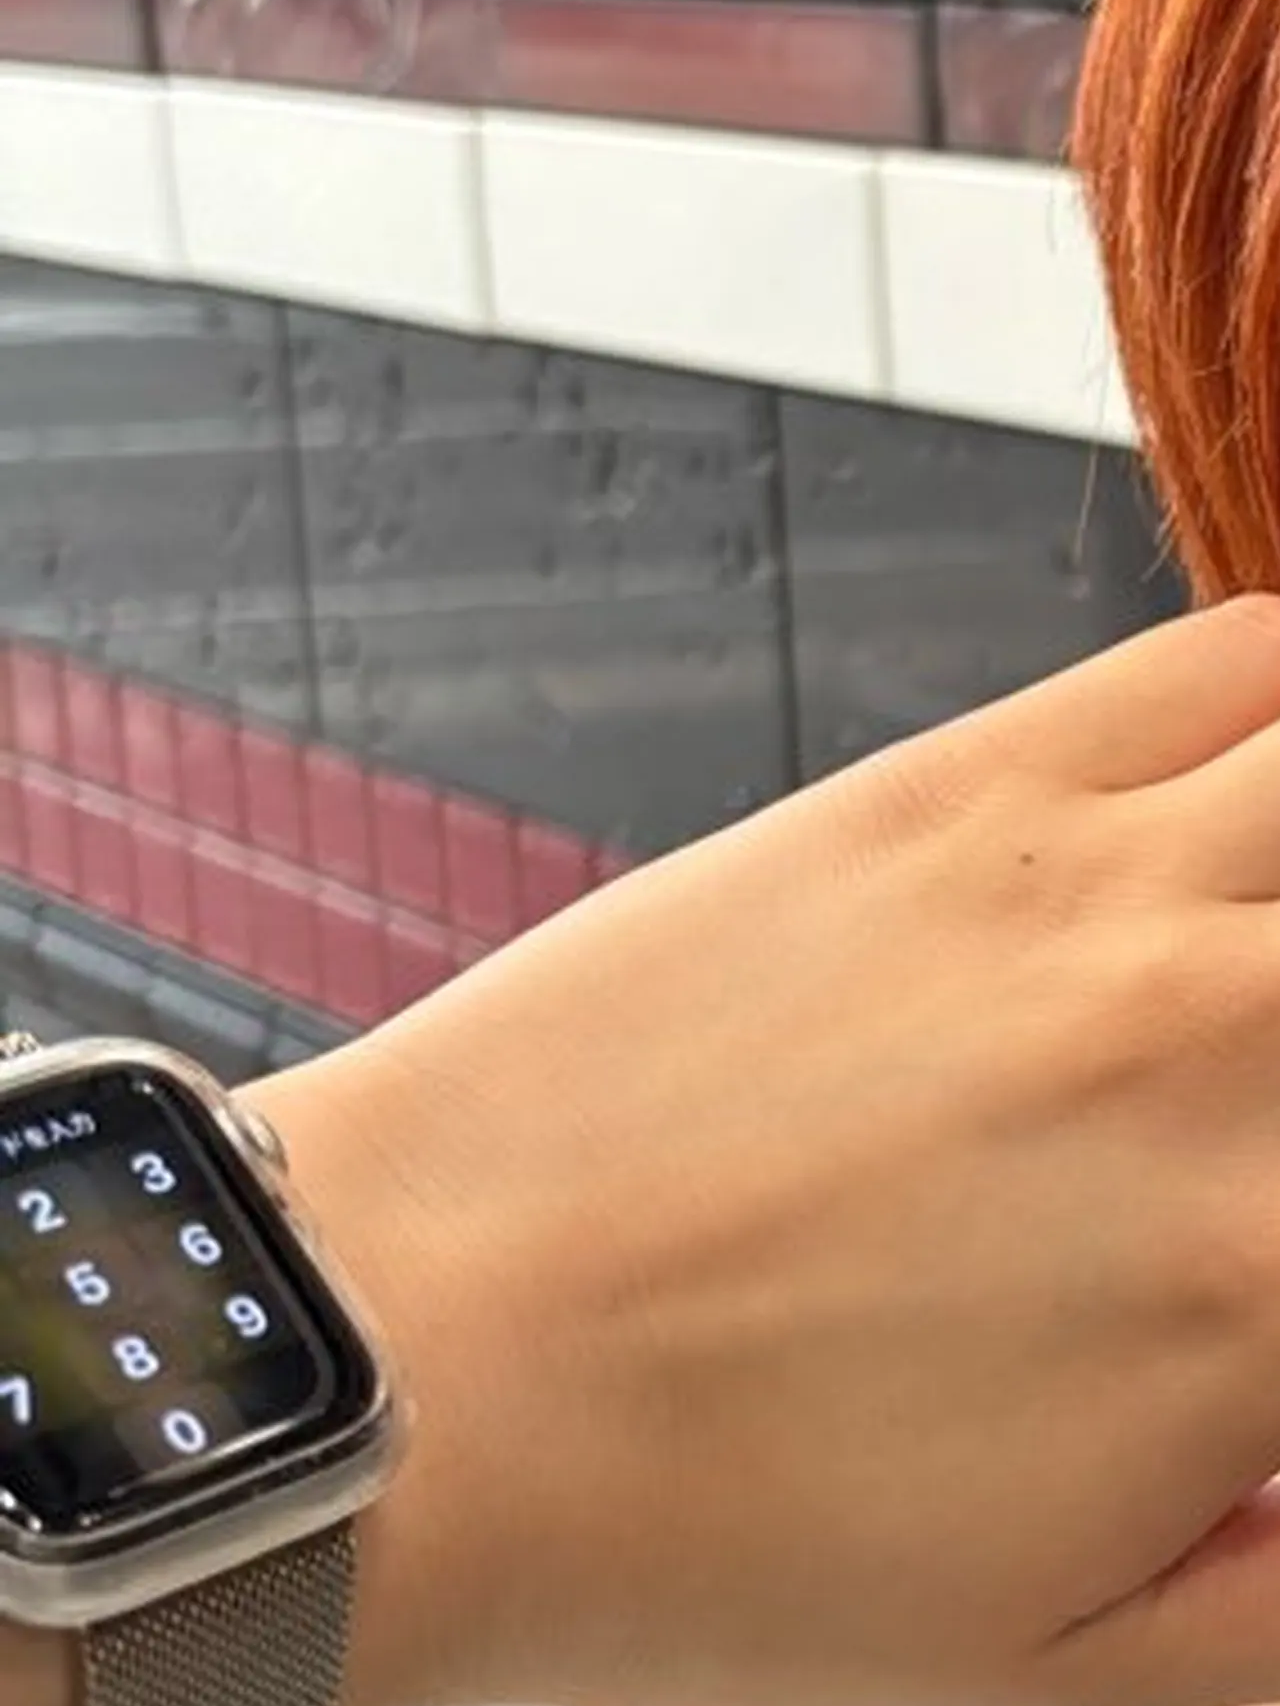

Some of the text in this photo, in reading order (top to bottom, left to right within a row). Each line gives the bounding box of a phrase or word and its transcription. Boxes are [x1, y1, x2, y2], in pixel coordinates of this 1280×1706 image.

[17, 1152, 176, 1234] 2 3
[64, 1223, 223, 1306] 5 6
[0, 1295, 268, 1424] 7 8 9
[161, 1408, 207, 1455] 0
